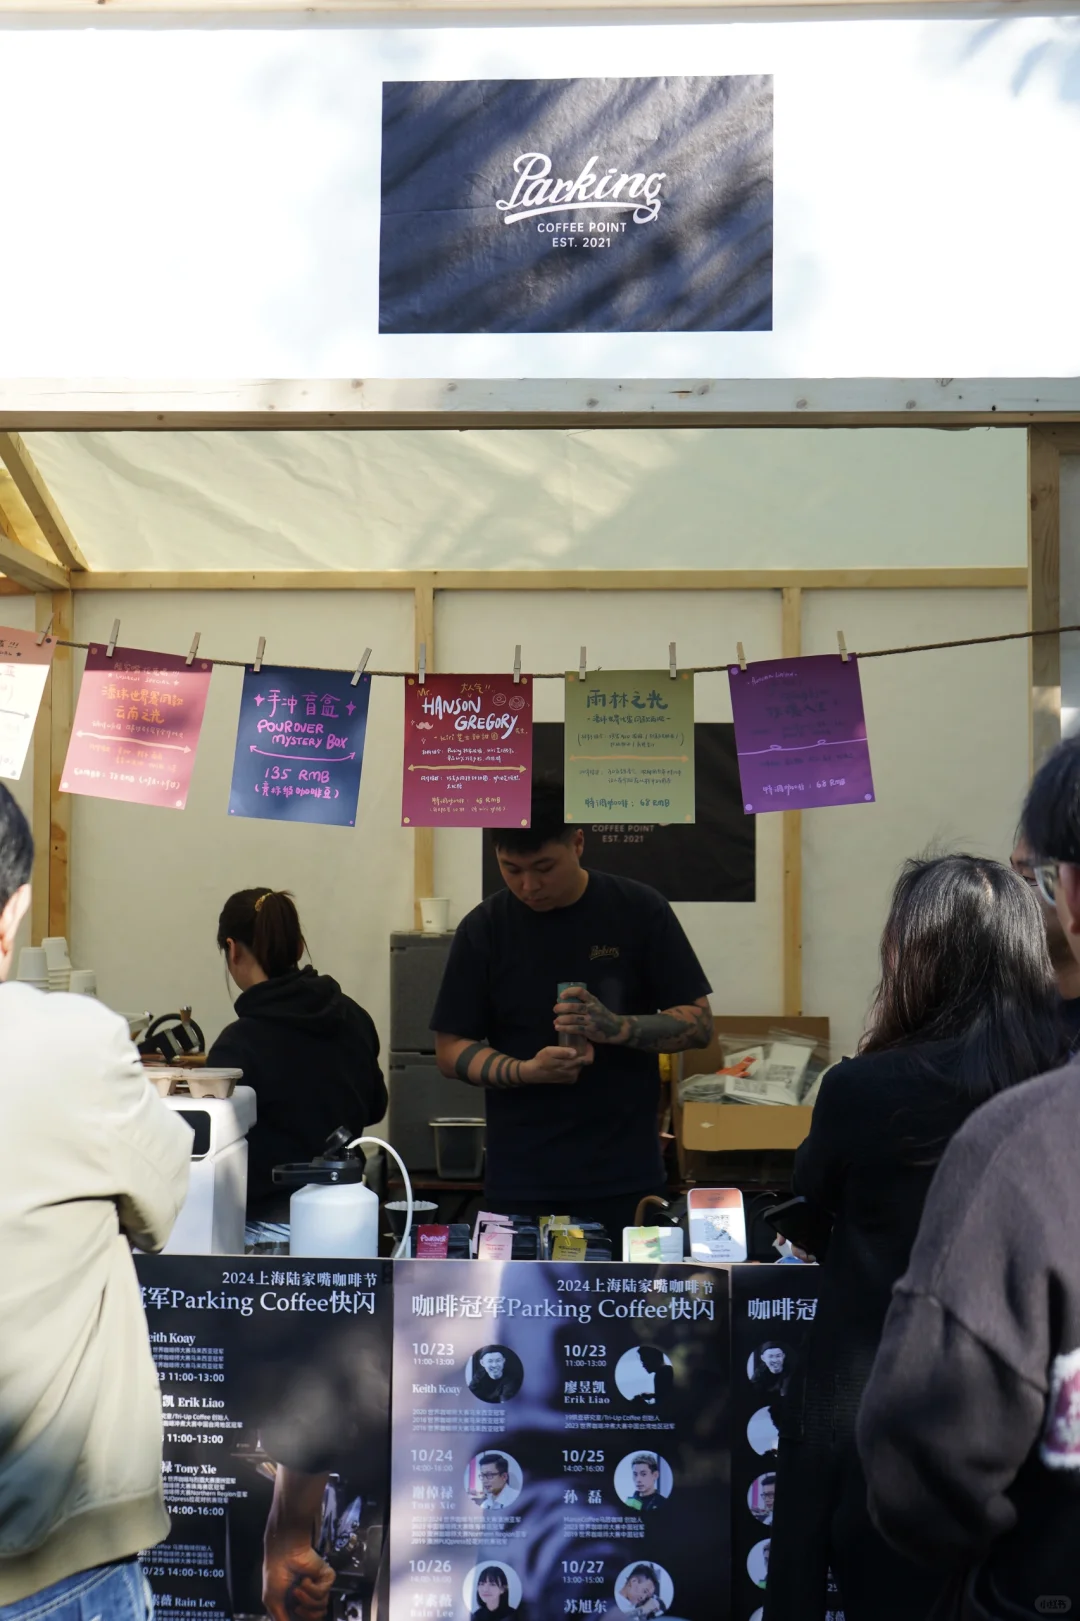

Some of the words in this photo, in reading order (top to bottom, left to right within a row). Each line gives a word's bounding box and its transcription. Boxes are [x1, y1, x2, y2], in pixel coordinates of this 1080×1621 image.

[495, 152, 667, 224] Parking
[537, 222, 584, 233] COFFEE
[589, 222, 627, 233] POINT
[552, 237, 577, 248] EST.
[582, 237, 612, 248] 2021
[267, 689, 341, 718] 手冲盲盒
[586, 689, 669, 709] 雨林之光
[422, 695, 481, 720] HANSON
[114, 705, 165, 724] 云南之光
[454, 713, 518, 740] GREGORY
[272, 734, 323, 748] MYSTERY
[326, 733, 349, 750] BOX
[265, 766, 292, 780] 135
[298, 769, 330, 783] RMB
[592, 824, 625, 832] COFFEE
[627, 824, 655, 832] POINT
[602, 834, 621, 843] EST.
[623, 834, 644, 843] 2021
[222, 1270, 378, 1288] 2024上海陆家嘴咖啡节
[557, 1278, 715, 1293] 2024上海陆家嘴咖啡节
[260, 1291, 376, 1315] Coffee快闪
[411, 1294, 593, 1324] 咖啡冠军Parking
[598, 1297, 716, 1321] Coffee快闪
[148, 1332, 167, 1343] eith
[169, 1333, 196, 1346] Koay
[412, 1342, 455, 1356] 10/23
[563, 1345, 606, 1357] 10/23
[413, 1358, 455, 1366] 11:00-13:00
[565, 1359, 607, 1367] 11:00-13:00
[168, 1372, 224, 1382] 11:00-13:00
[411, 1383, 437, 1394] Keith
[438, 1384, 462, 1396] Koay
[563, 1380, 606, 1394] 廖昱凯
[178, 1397, 200, 1408] Erik
[202, 1398, 224, 1408] Liao
[564, 1396, 585, 1404] Erik
[588, 1396, 611, 1404] Liao
[167, 1434, 224, 1444] 11:00-13:00
[410, 1449, 453, 1462] 10/24
[562, 1449, 604, 1462] 10/25
[174, 1464, 199, 1476] Tony
[200, 1464, 217, 1475] Xie
[167, 1505, 224, 1516] 14:00-16:00
[412, 1501, 436, 1512] Tony
[142, 1567, 165, 1576] 0/25
[167, 1567, 225, 1578] 14:00-16:00
[409, 1560, 452, 1573] 10/26
[561, 1561, 604, 1573] 10/27
[175, 1597, 196, 1607] Rain
[199, 1598, 217, 1608] Lee
[563, 1598, 607, 1613] 苏旭东
